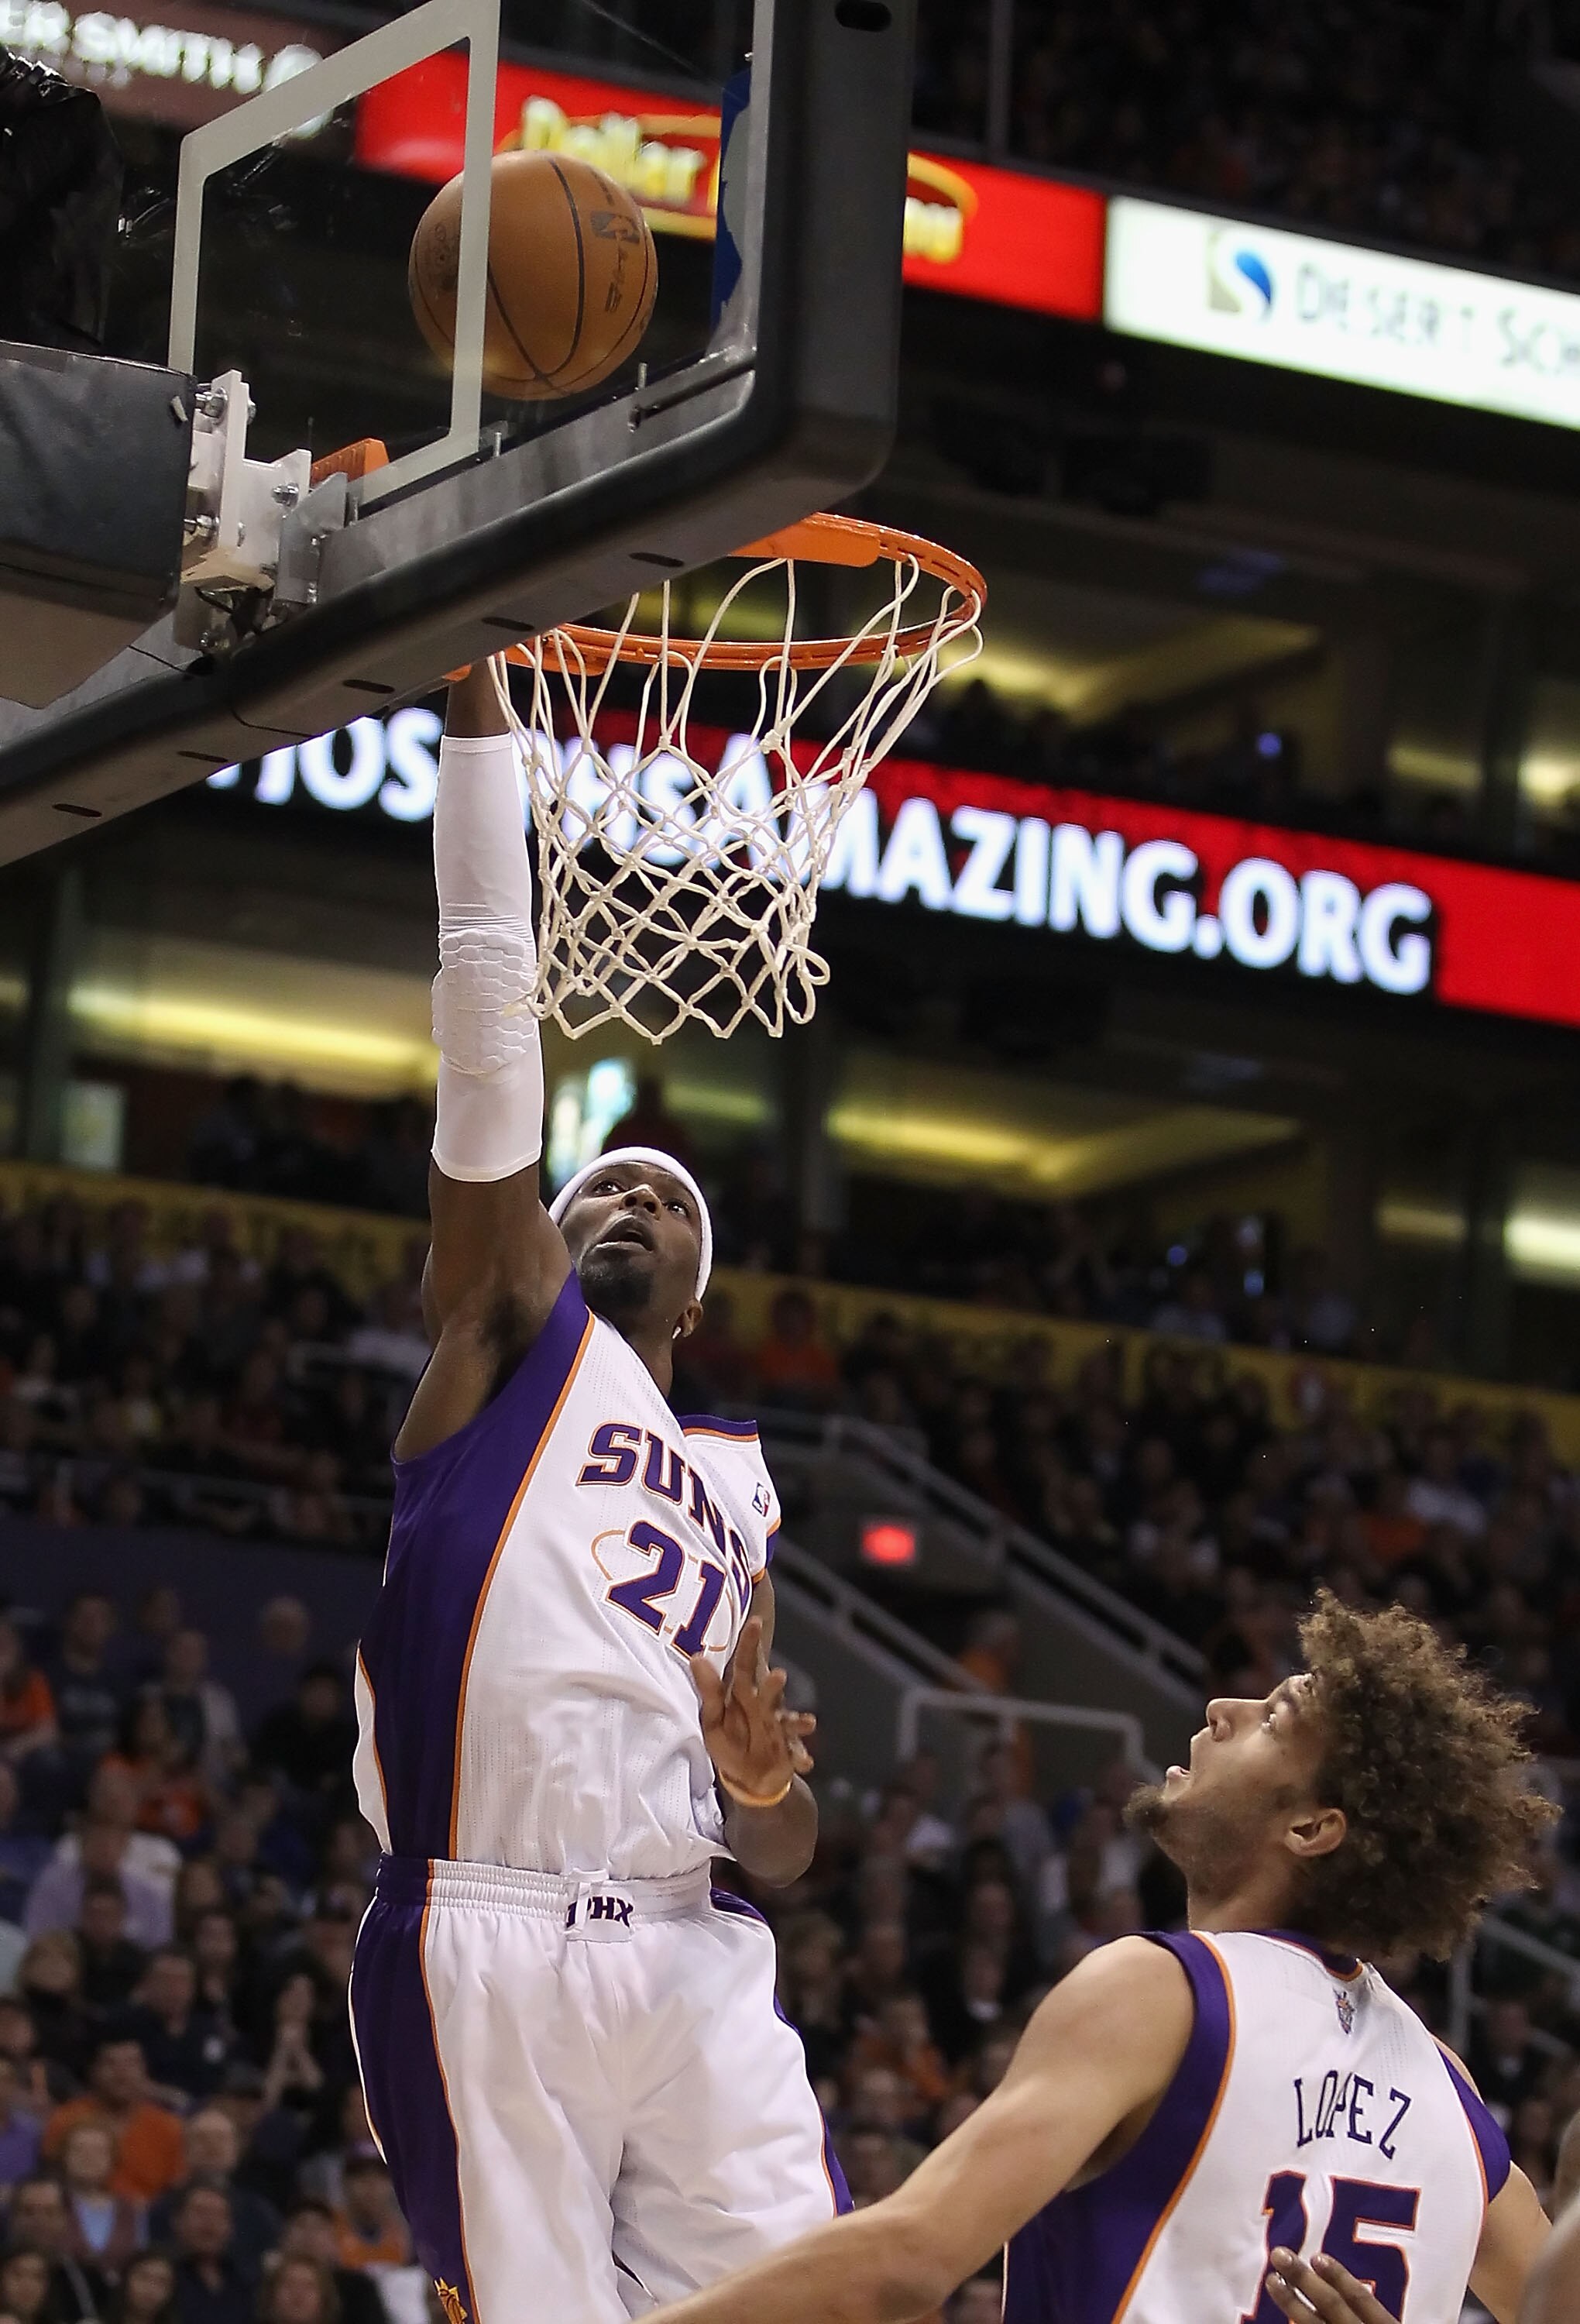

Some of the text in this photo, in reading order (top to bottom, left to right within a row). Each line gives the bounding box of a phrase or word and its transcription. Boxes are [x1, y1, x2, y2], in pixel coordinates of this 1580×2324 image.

[575, 1420, 753, 1621] SUNS
[604, 1520, 726, 1659] 21
[1293, 2069, 1411, 2160] LOPEZ
[1241, 2170, 1421, 2324] 15
